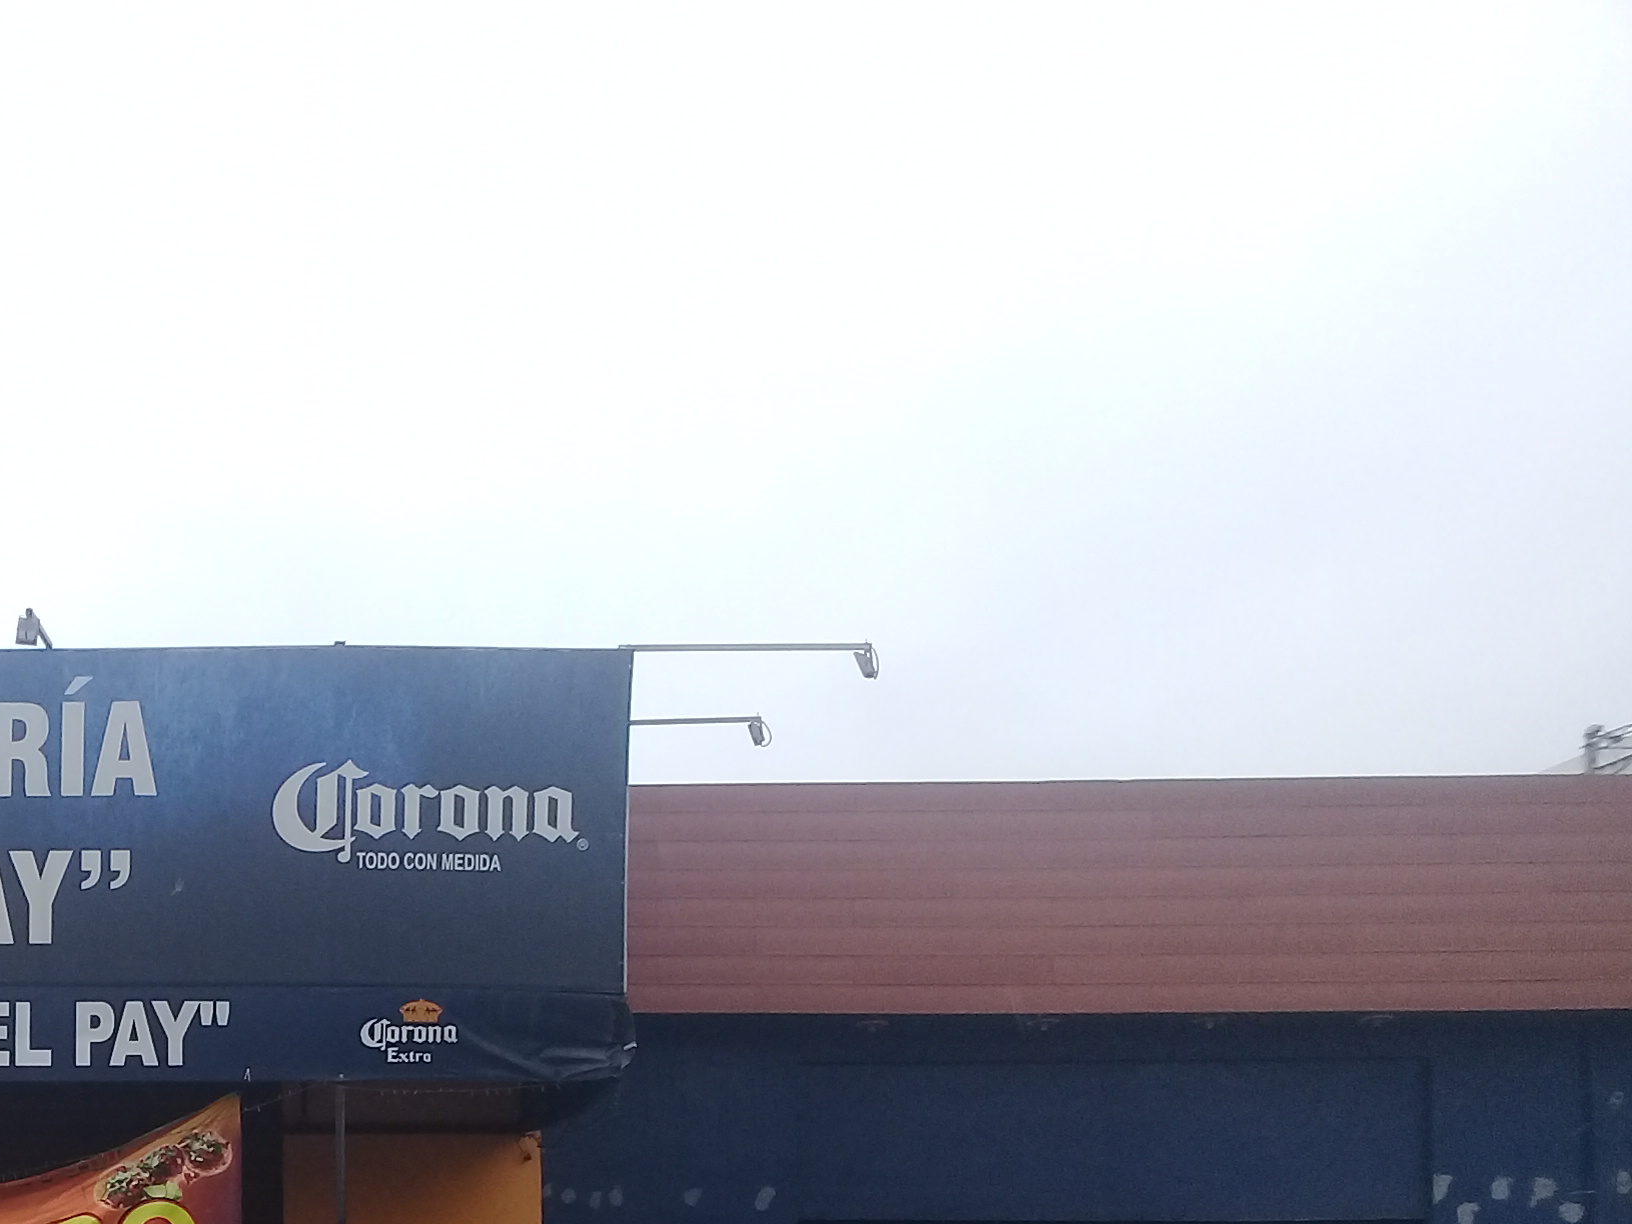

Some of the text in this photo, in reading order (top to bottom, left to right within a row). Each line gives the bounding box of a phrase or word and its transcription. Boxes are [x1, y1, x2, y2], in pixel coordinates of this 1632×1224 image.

[272, 759, 580, 862] Corona
[356, 852, 502, 872] TODO CON MEDIDA
[360, 1018, 459, 1050] Corona
[386, 1047, 432, 1063] Extra
